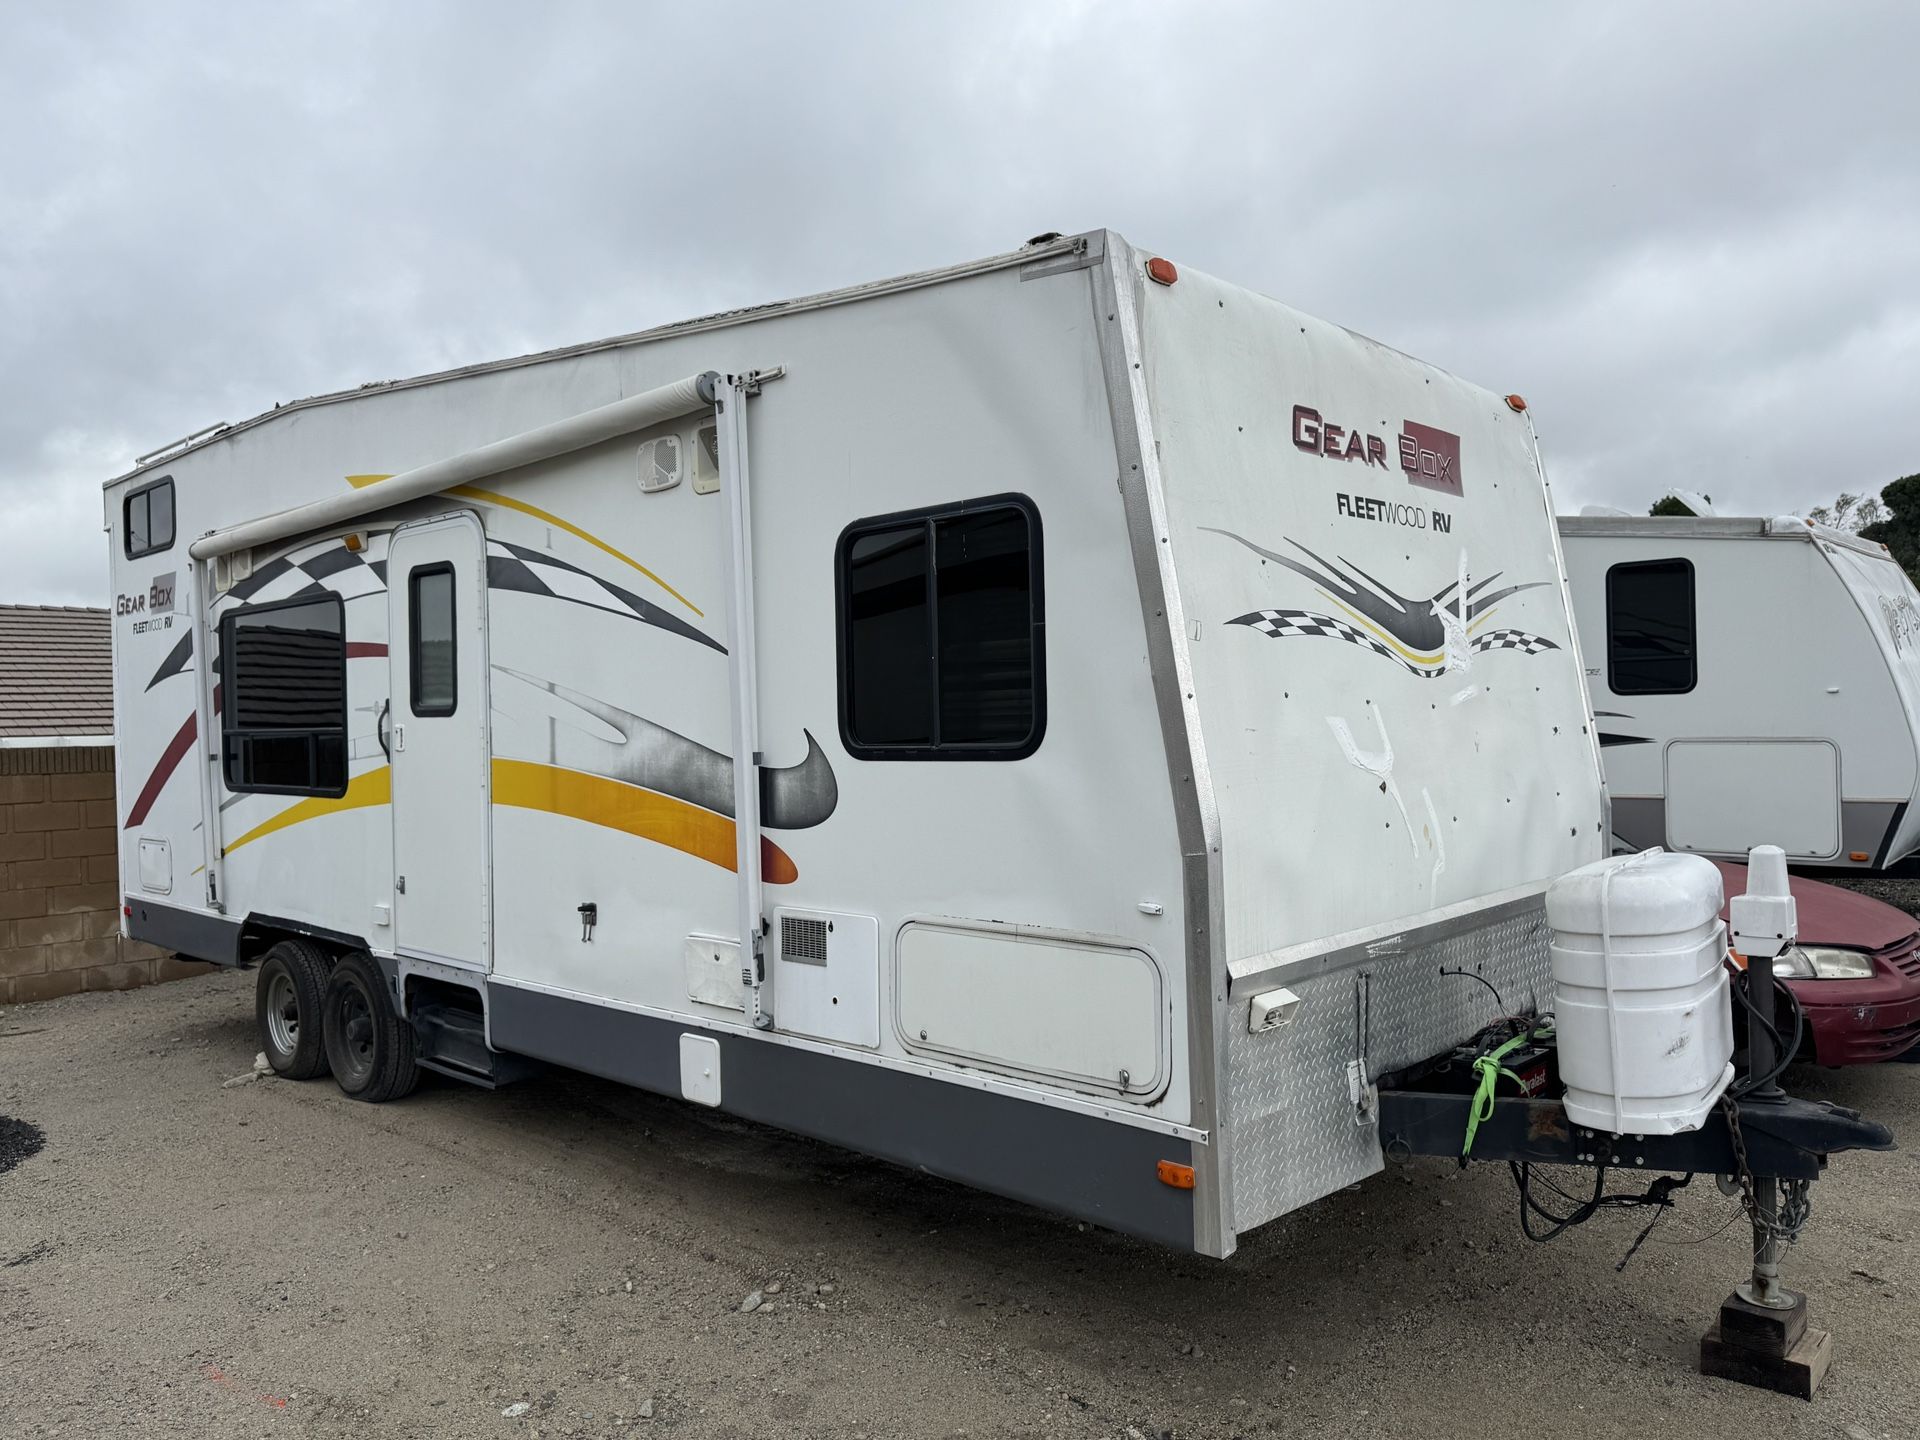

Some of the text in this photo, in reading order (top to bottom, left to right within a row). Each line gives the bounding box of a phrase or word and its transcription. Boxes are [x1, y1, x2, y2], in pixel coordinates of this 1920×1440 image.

[1292, 404, 1454, 485] GEAR BOX
[1336, 492, 1451, 534] FLEETWOOD RV
[117, 585, 173, 616] GEAR BOX
[133, 615, 174, 635] FLEETWOOD RV
